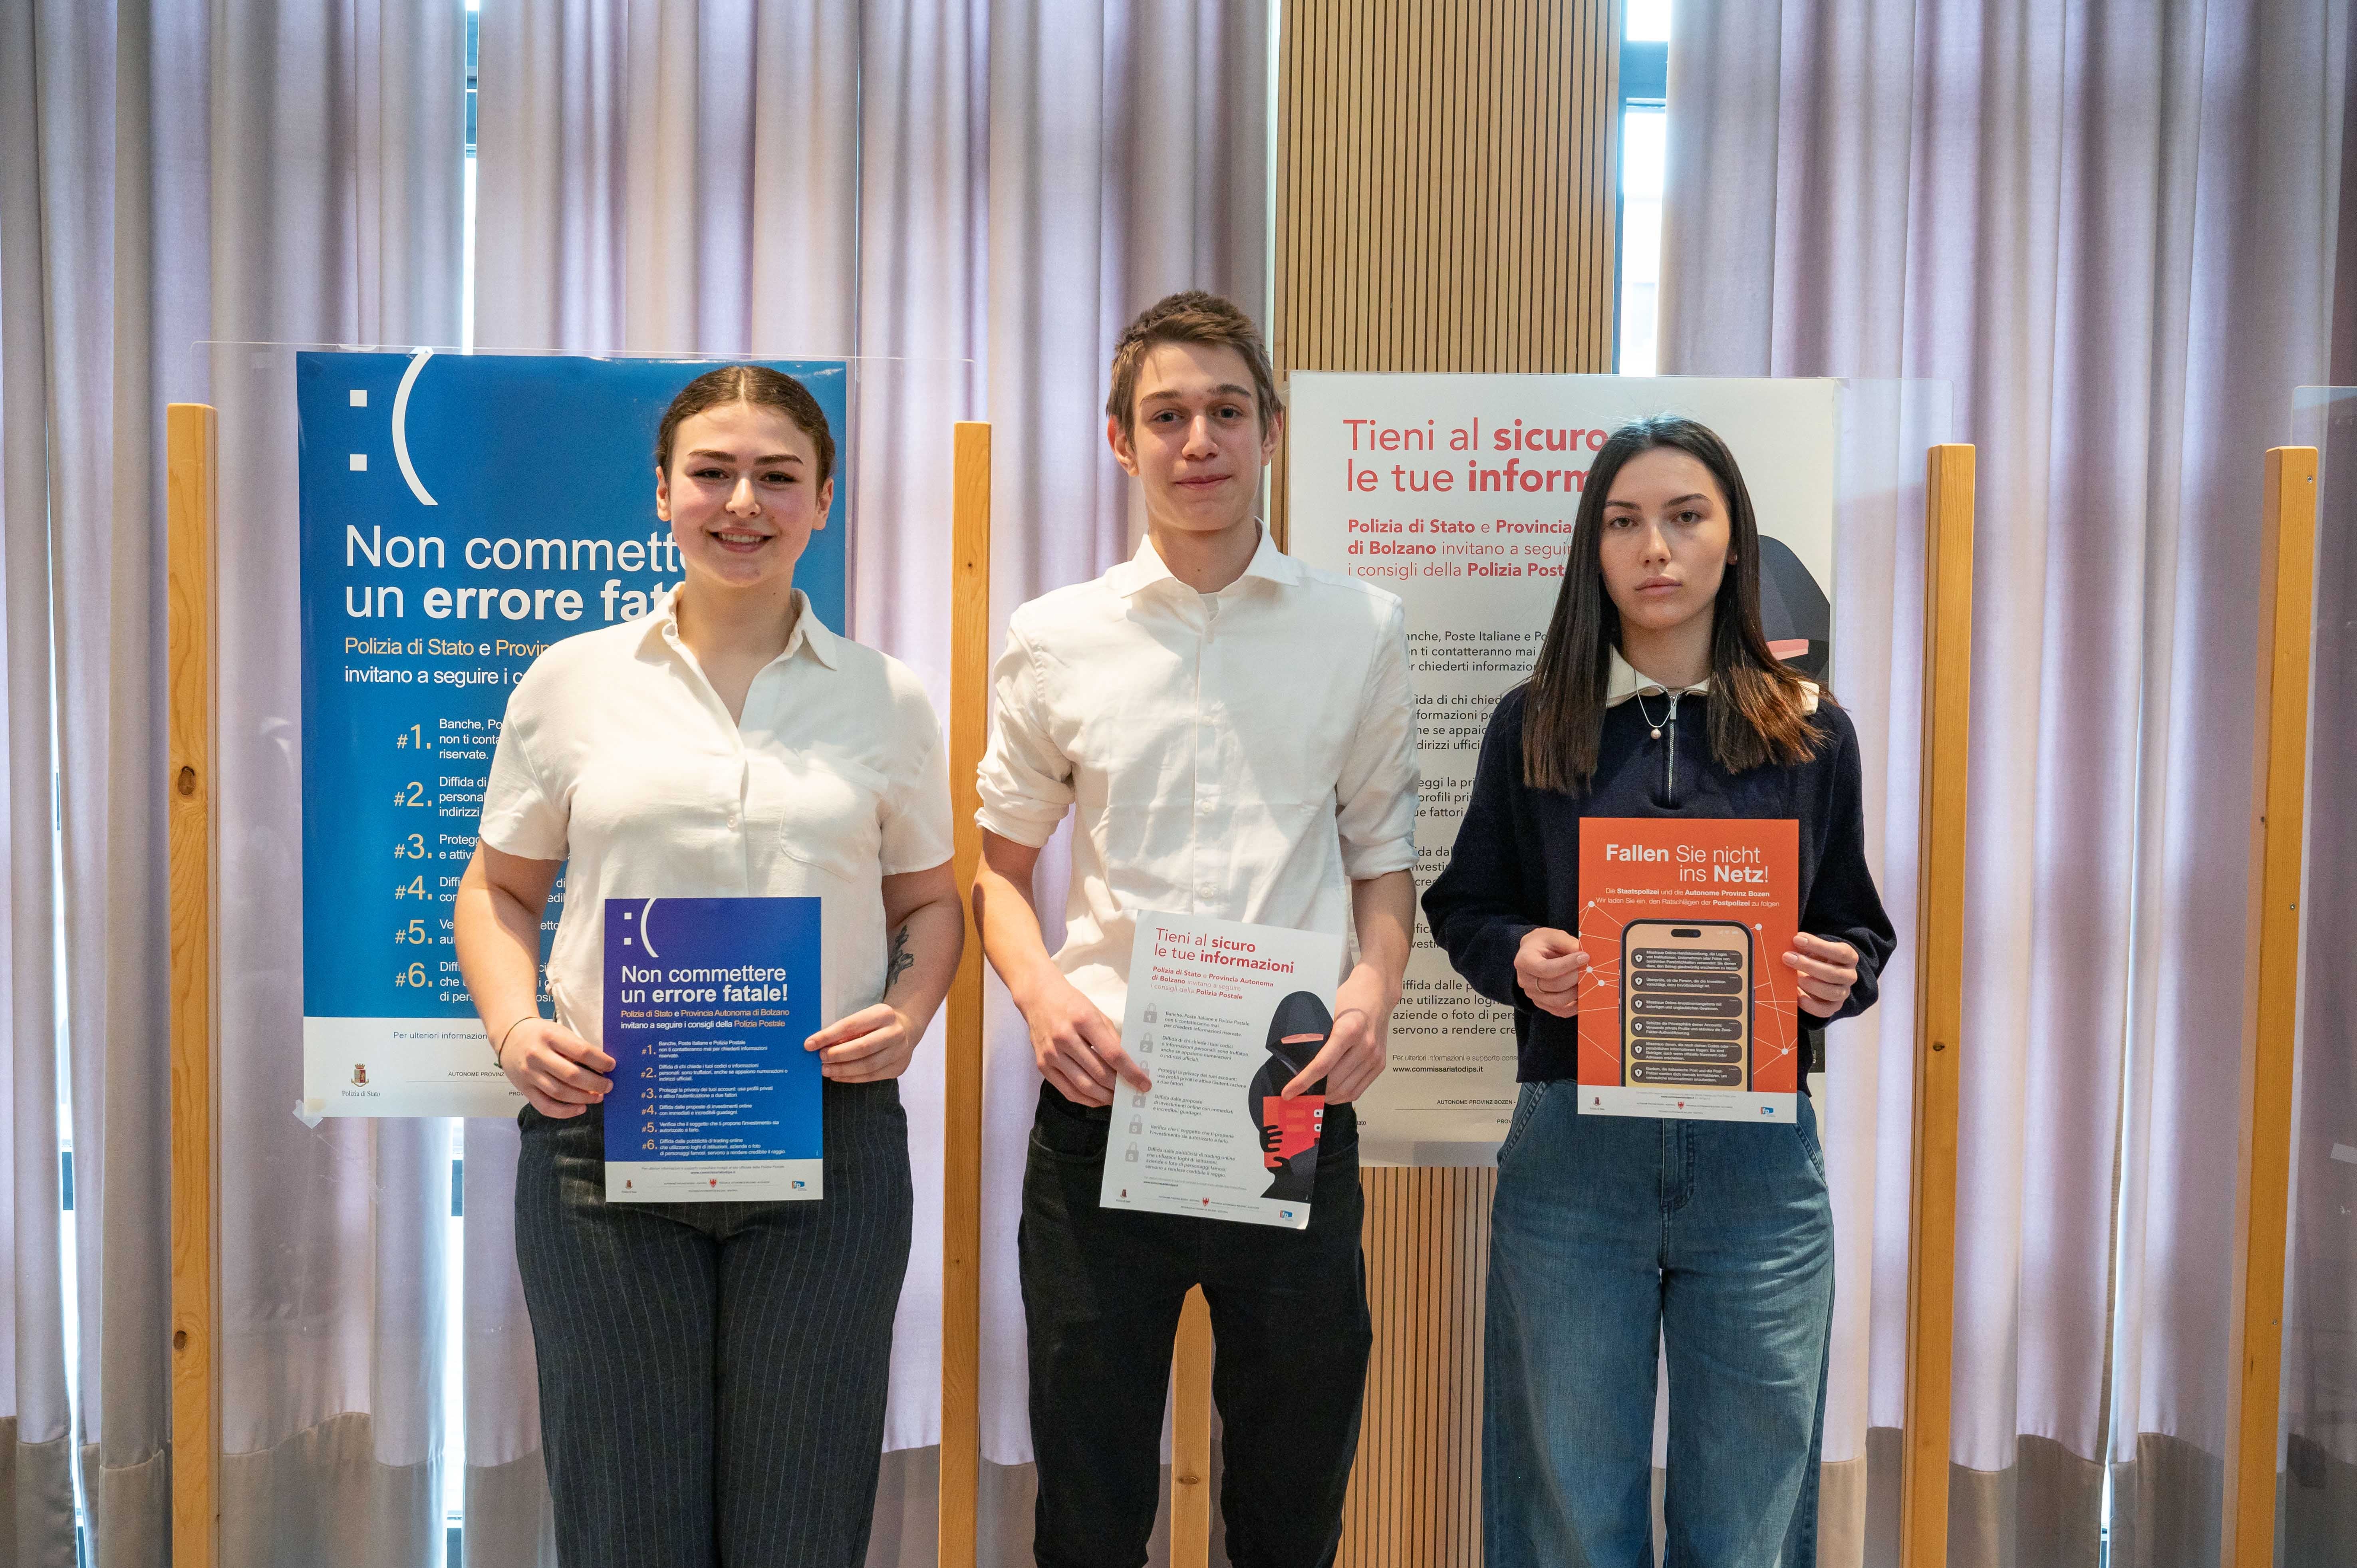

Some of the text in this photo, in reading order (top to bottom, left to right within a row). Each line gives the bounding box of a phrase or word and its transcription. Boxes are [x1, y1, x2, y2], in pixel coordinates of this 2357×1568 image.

[1343, 417, 1608, 452] Tieni al sicuro
[1348, 458, 1378, 492] le
[1391, 464, 1454, 492] tue
[1348, 518, 1572, 534] Polizia di Stato e Provincia
[347, 524, 445, 568] Non
[1348, 540, 1363, 554] di
[1370, 540, 1436, 555] Bolzano
[1442, 541, 1504, 555] invitano
[1510, 545, 1518, 555] a
[1357, 562, 1417, 580] consigli
[1423, 562, 1461, 576] della
[1467, 562, 1521, 576] Polizia
[346, 586, 403, 617] un
[423, 587, 583, 621] errore
[1445, 630, 1521, 641] Poste Italiane
[345, 637, 402, 655] Polizia
[407, 638, 422, 655] di
[428, 638, 474, 656] Stato
[479, 643, 490, 656] e
[1420, 646, 1535, 656] ti contatteranno mai
[1418, 660, 1468, 671] chiederti
[345, 665, 499, 687] invitano a seguire
[1437, 694, 1467, 705] di chi
[439, 718, 484, 730] Banche,
[396, 724, 431, 749] #1.
[463, 734, 469, 744] ti
[439, 748, 488, 759] riservate.
[439, 776, 486, 787] Diffida di
[393, 781, 432, 807] #2.
[439, 806, 479, 817] indirizzi
[394, 833, 432, 859] #3.
[1606, 844, 1761, 863] Fallen Sie nicht
[1680, 864, 1768, 883] ins Netz!
[394, 875, 432, 900] #4.
[395, 919, 433, 945] #5.
[1156, 927, 1256, 953] Tieni al sicuro
[1154, 943, 1294, 973] le tue informazioni
[395, 962, 433, 987] #6.
[439, 976, 459, 986] che
[622, 965, 786, 983] Non commettere
[1153, 966, 1174, 974] Polizia
[1209, 973, 1238, 982] Provincia
[1239, 977, 1273, 987] Autonoma
[1160, 975, 1185, 984] Bolzano
[1154, 984, 1178, 993] consigli
[1196, 988, 1217, 996] Polizia
[1219, 991, 1243, 1000] Postale
[1434, 980, 1462, 990] dalle
[621, 984, 787, 1003] un errore fatale!
[1417, 994, 1470, 1004] utilizzano
[1393, 1009, 1489, 1020] aziende foto di
[656, 1021, 683, 1030] seguire
[687, 1020, 714, 1030] consigli
[1452, 1024, 1496, 1034] rendere
[641, 1044, 656, 1055] #1.
[641, 1067, 657, 1078] #2.
[641, 1088, 657, 1099] #3.
[641, 1104, 657, 1115] #4.
[642, 1122, 657, 1133] #5.
[642, 1139, 657, 1150] #6.
